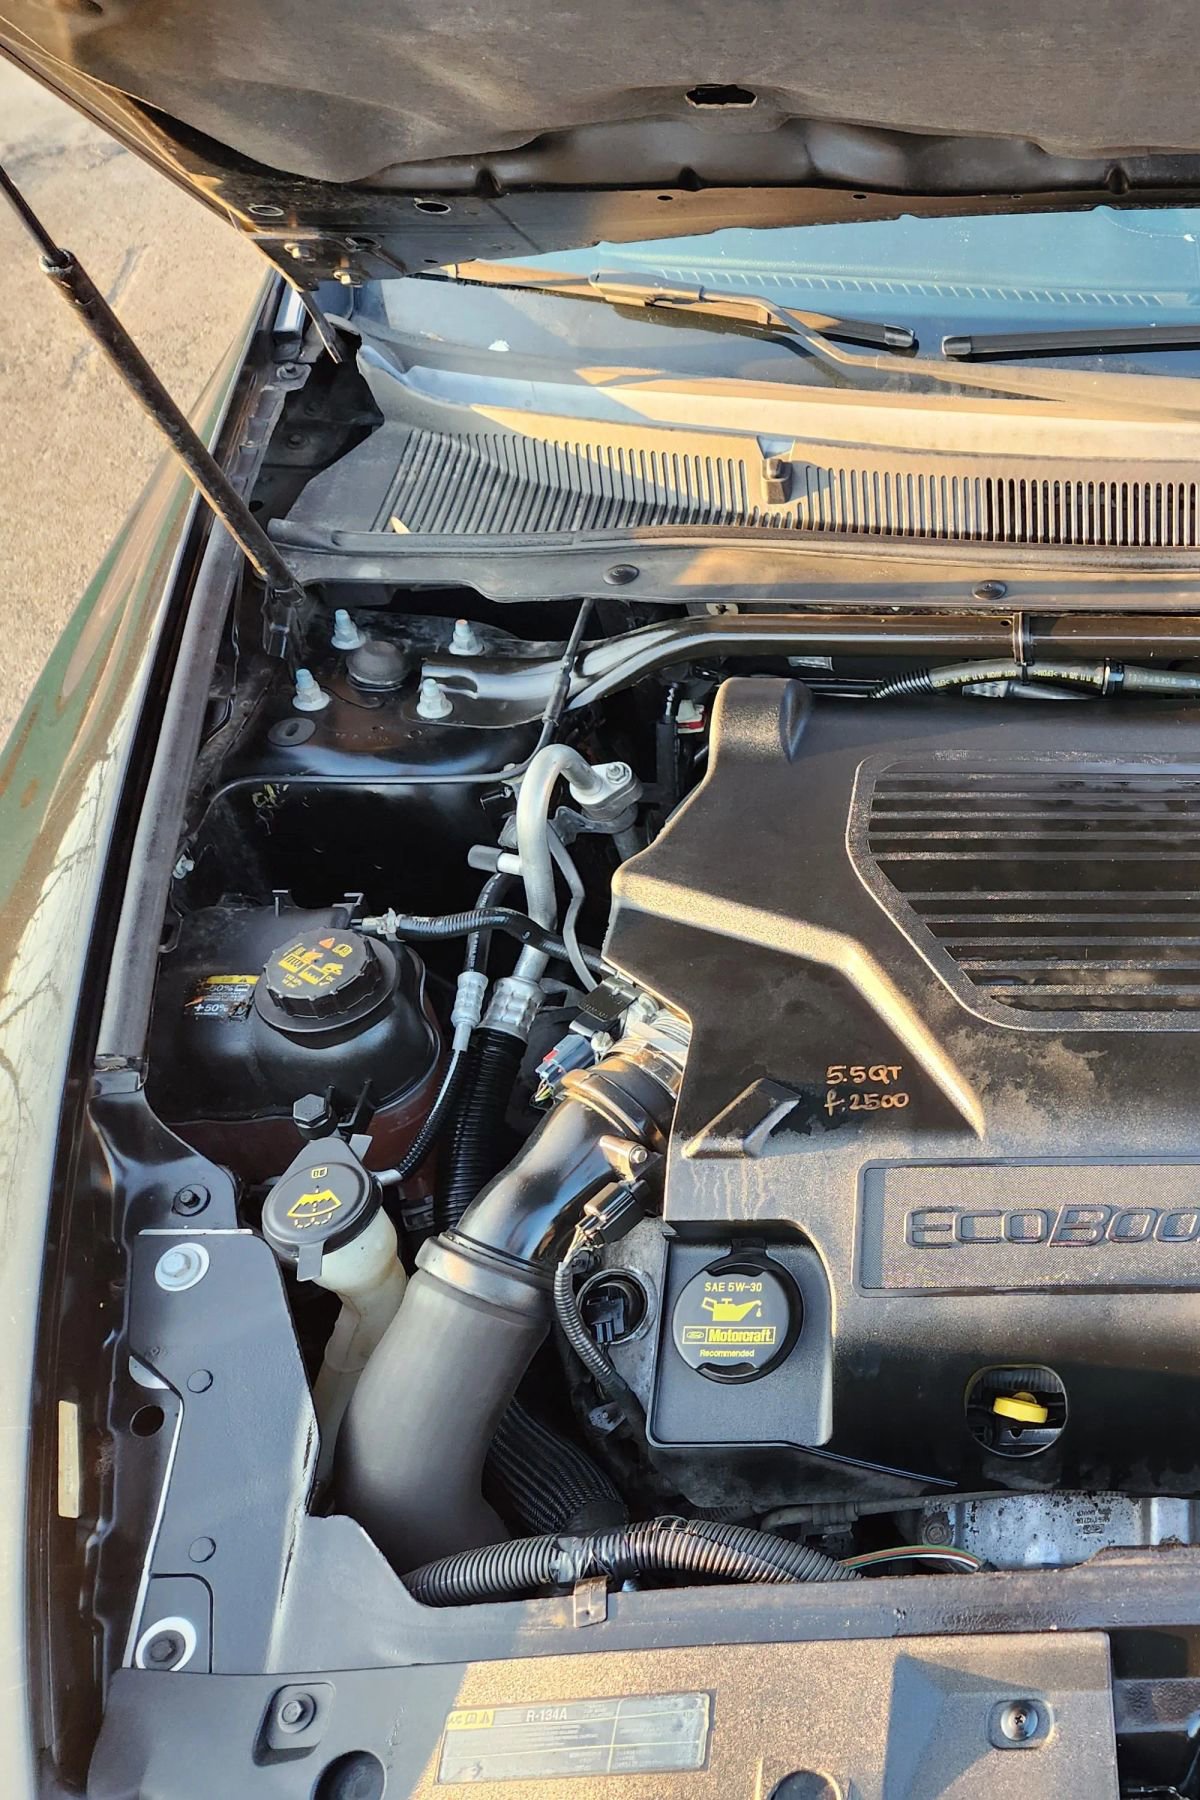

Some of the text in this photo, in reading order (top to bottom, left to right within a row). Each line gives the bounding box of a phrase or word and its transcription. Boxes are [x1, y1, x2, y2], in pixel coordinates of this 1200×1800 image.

[704, 1282, 763, 1292] SAE 5W-30
[708, 1328, 773, 1343] Motorcraft
[699, 1348, 755, 1358] Recommended
